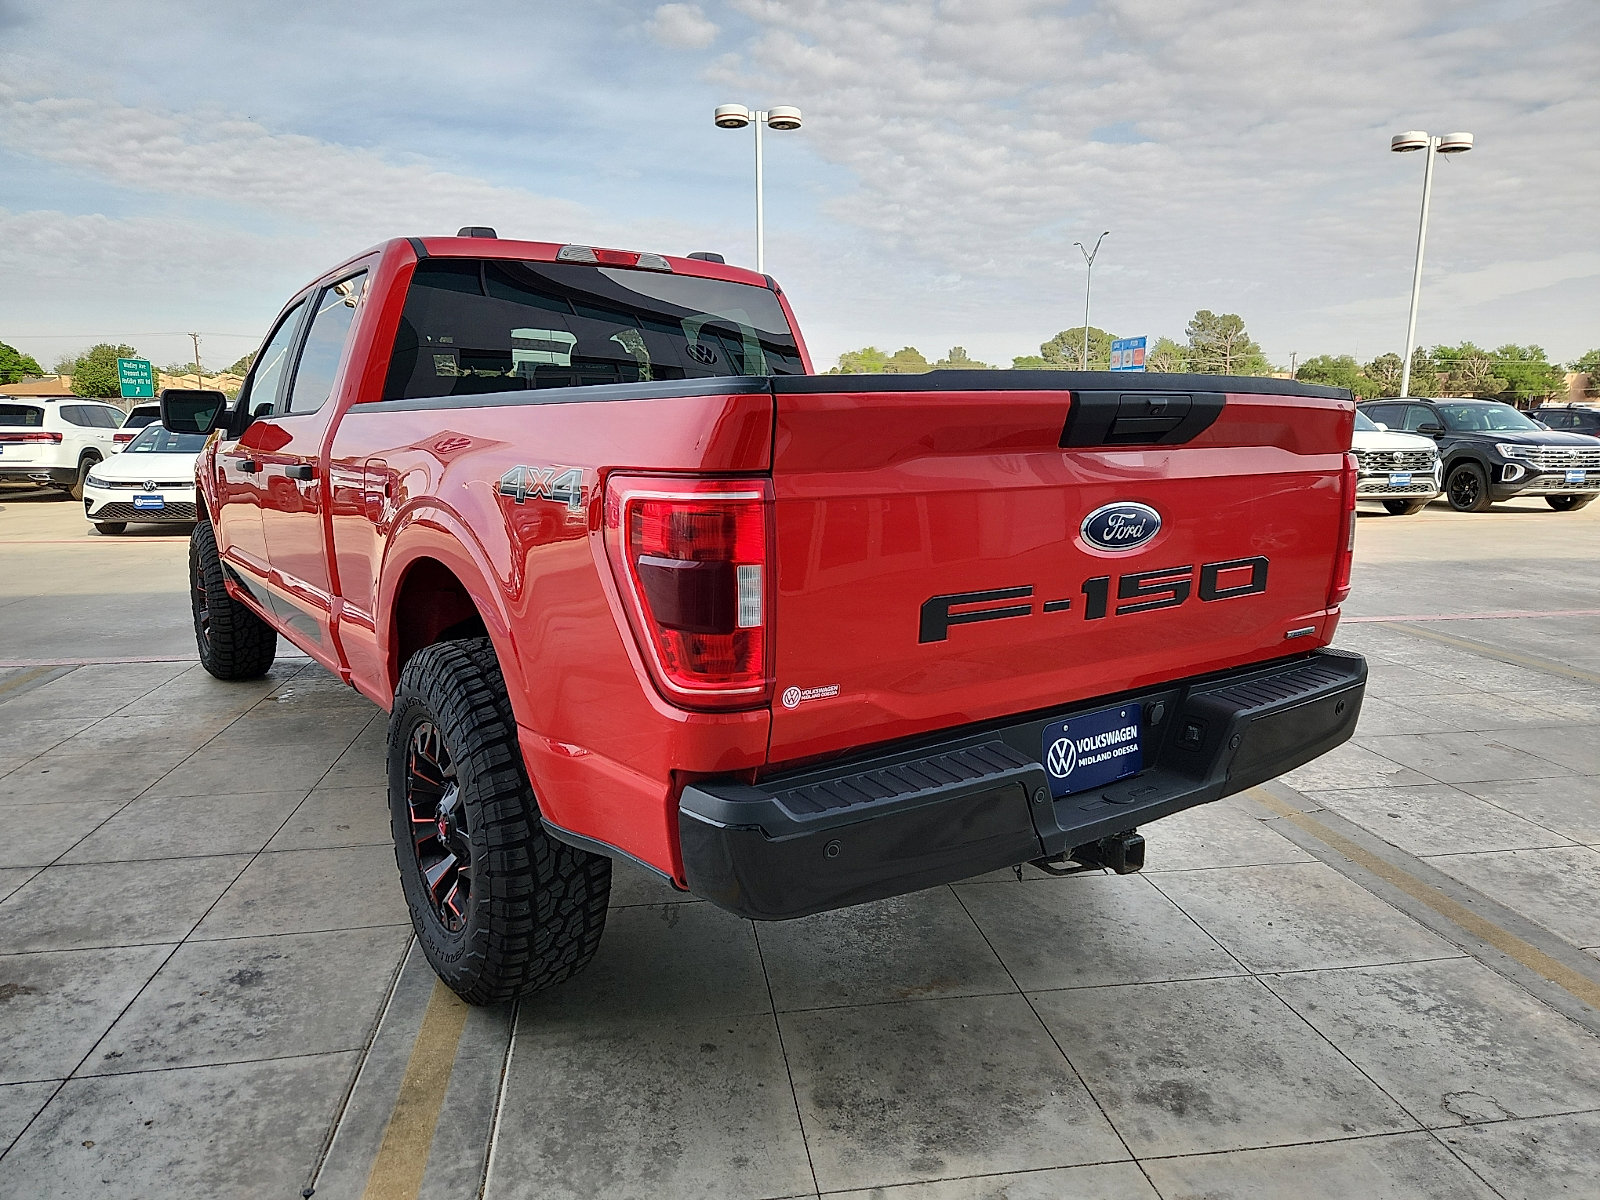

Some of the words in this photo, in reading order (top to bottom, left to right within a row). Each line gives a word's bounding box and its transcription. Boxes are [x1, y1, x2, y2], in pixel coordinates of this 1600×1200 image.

[1103, 514, 1144, 541] Ford
[919, 556, 1269, 643] F-150
[802, 685, 839, 695] VOLKSWAGEN
[1076, 725, 1138, 753] VOLKSWAGEN
[1078, 751, 1112, 767] MIDLAND
[1112, 743, 1139, 758] ODESSA
